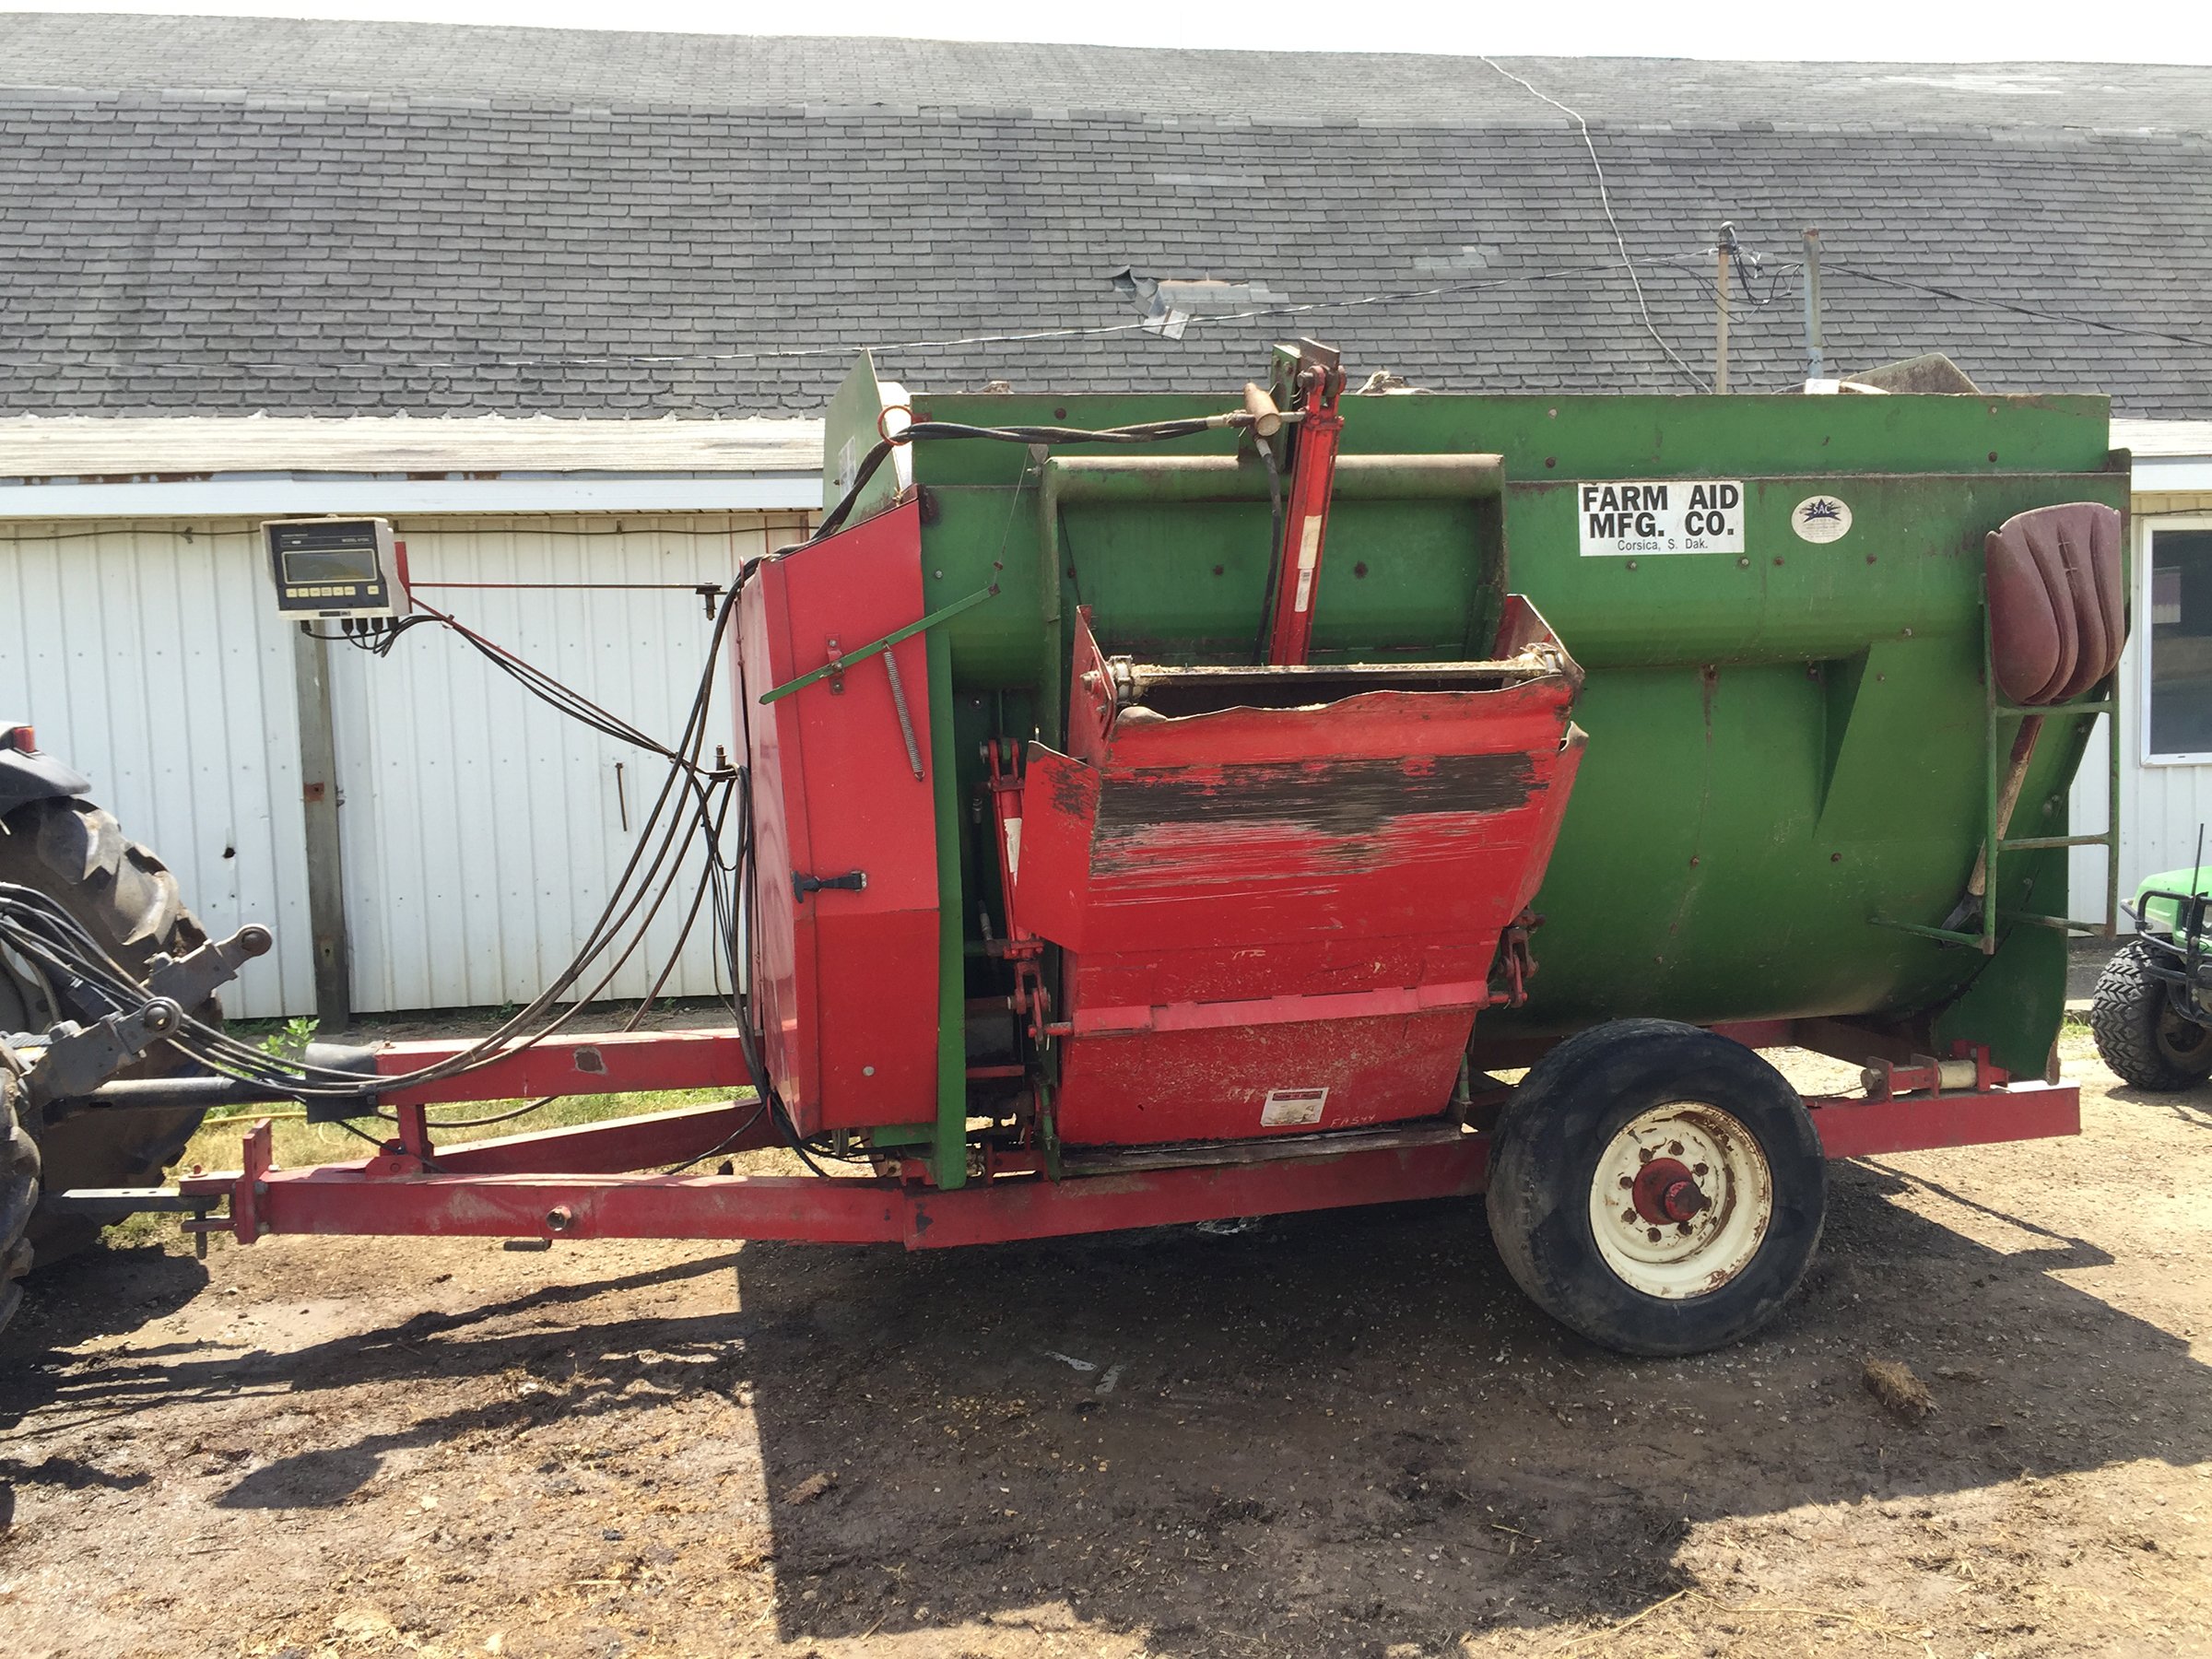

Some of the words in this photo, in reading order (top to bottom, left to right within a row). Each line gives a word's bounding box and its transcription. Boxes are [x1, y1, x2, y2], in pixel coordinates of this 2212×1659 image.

[1583, 486, 1668, 512] FARM
[1688, 484, 1739, 510] AID
[1813, 503, 1831, 514] SAC
[1589, 512, 1665, 538] MFG.
[1685, 511, 1734, 536] CO.
[1618, 539, 1661, 551] Corsica,
[1667, 538, 1678, 549] S.
[1686, 538, 1708, 549] Dak.
